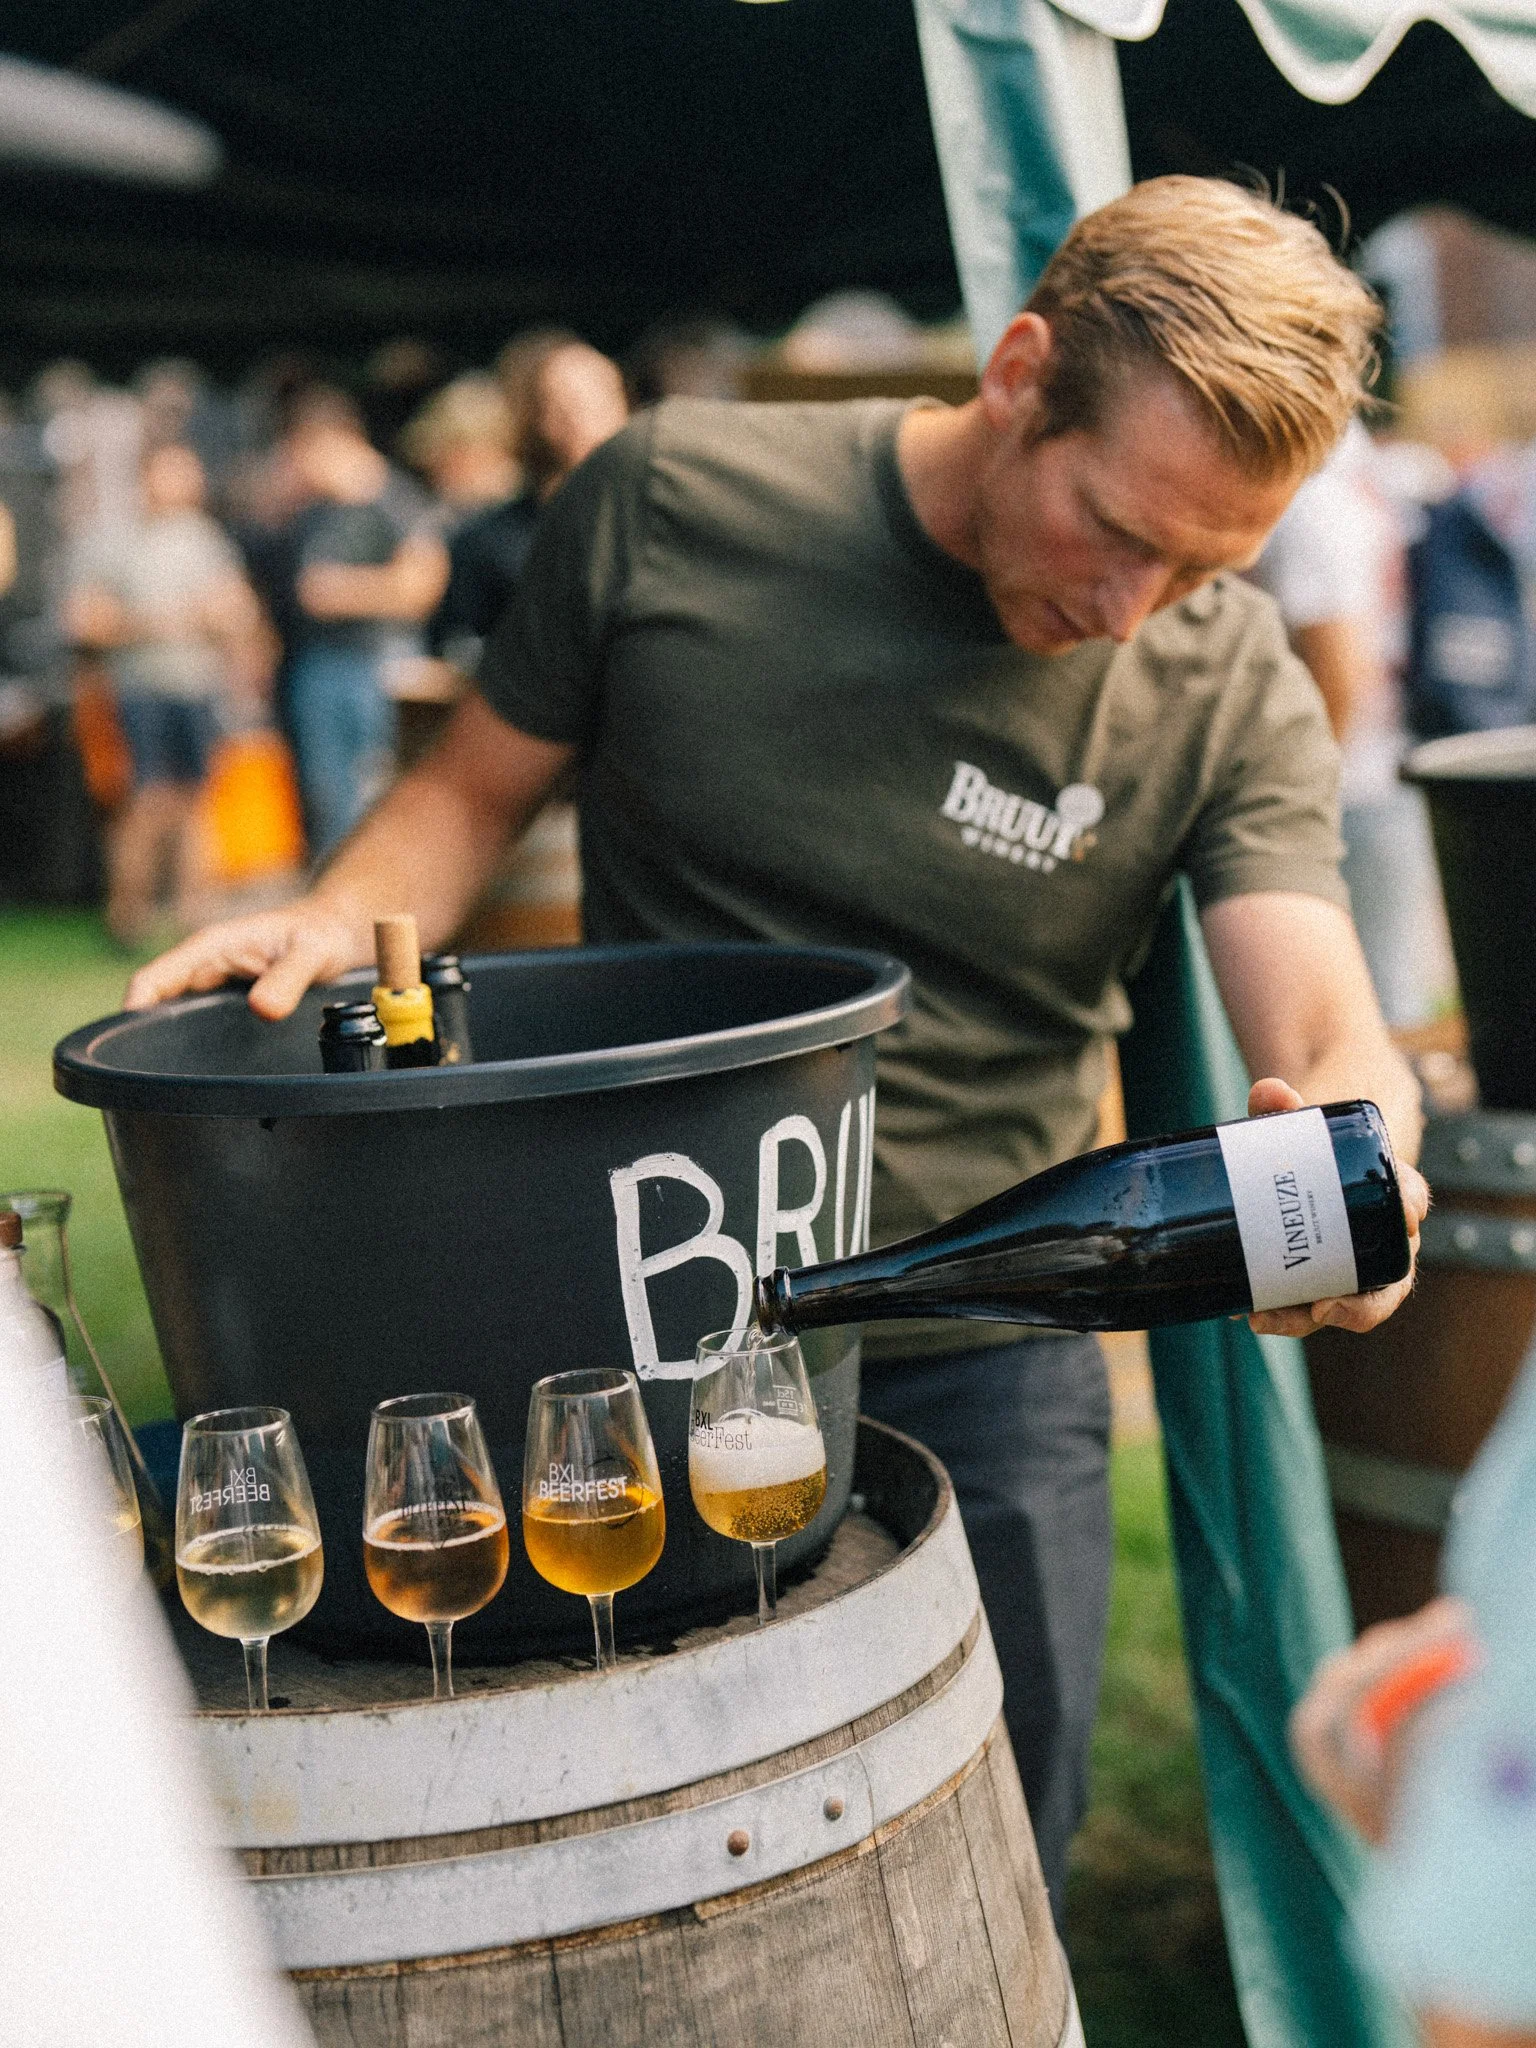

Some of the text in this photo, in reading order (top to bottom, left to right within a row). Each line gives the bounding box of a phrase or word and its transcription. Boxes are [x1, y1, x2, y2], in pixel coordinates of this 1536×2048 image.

[1273, 1171, 1311, 1270] VINEUZE
[695, 1409, 713, 1431] BXL
[549, 1462, 577, 1482] BXL
[539, 1475, 629, 1503] BEERFEST
